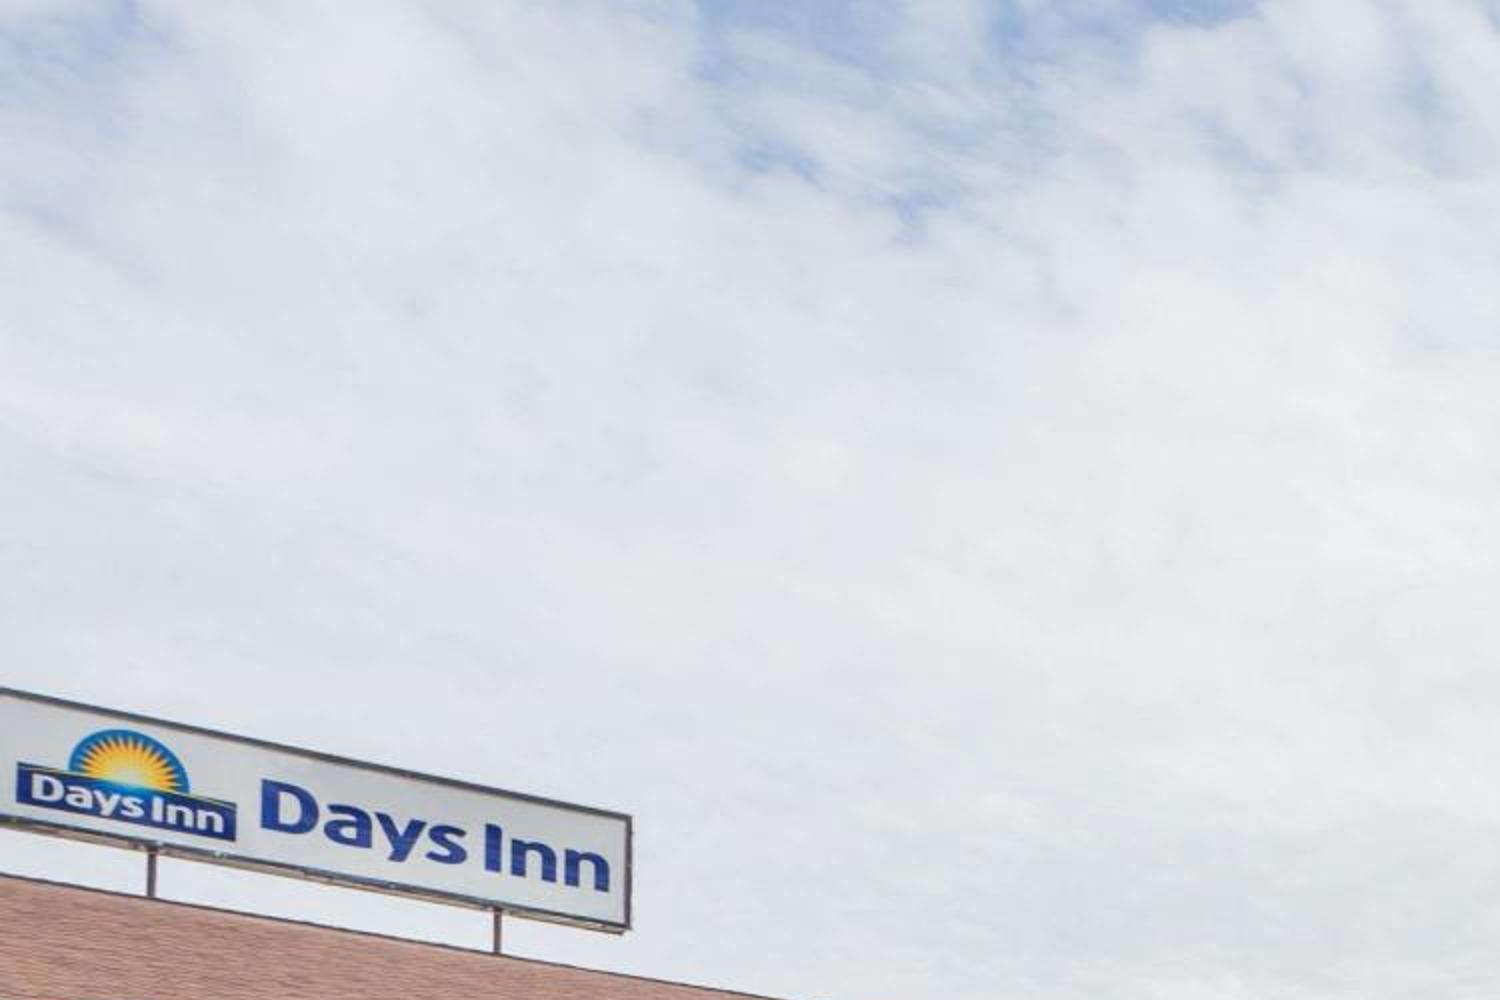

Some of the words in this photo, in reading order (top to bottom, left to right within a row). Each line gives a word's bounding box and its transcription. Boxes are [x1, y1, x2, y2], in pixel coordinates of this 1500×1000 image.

[32, 773, 144, 818] Days
[152, 796, 223, 833] Inn
[260, 778, 467, 863] Days
[484, 823, 609, 892] Inn
